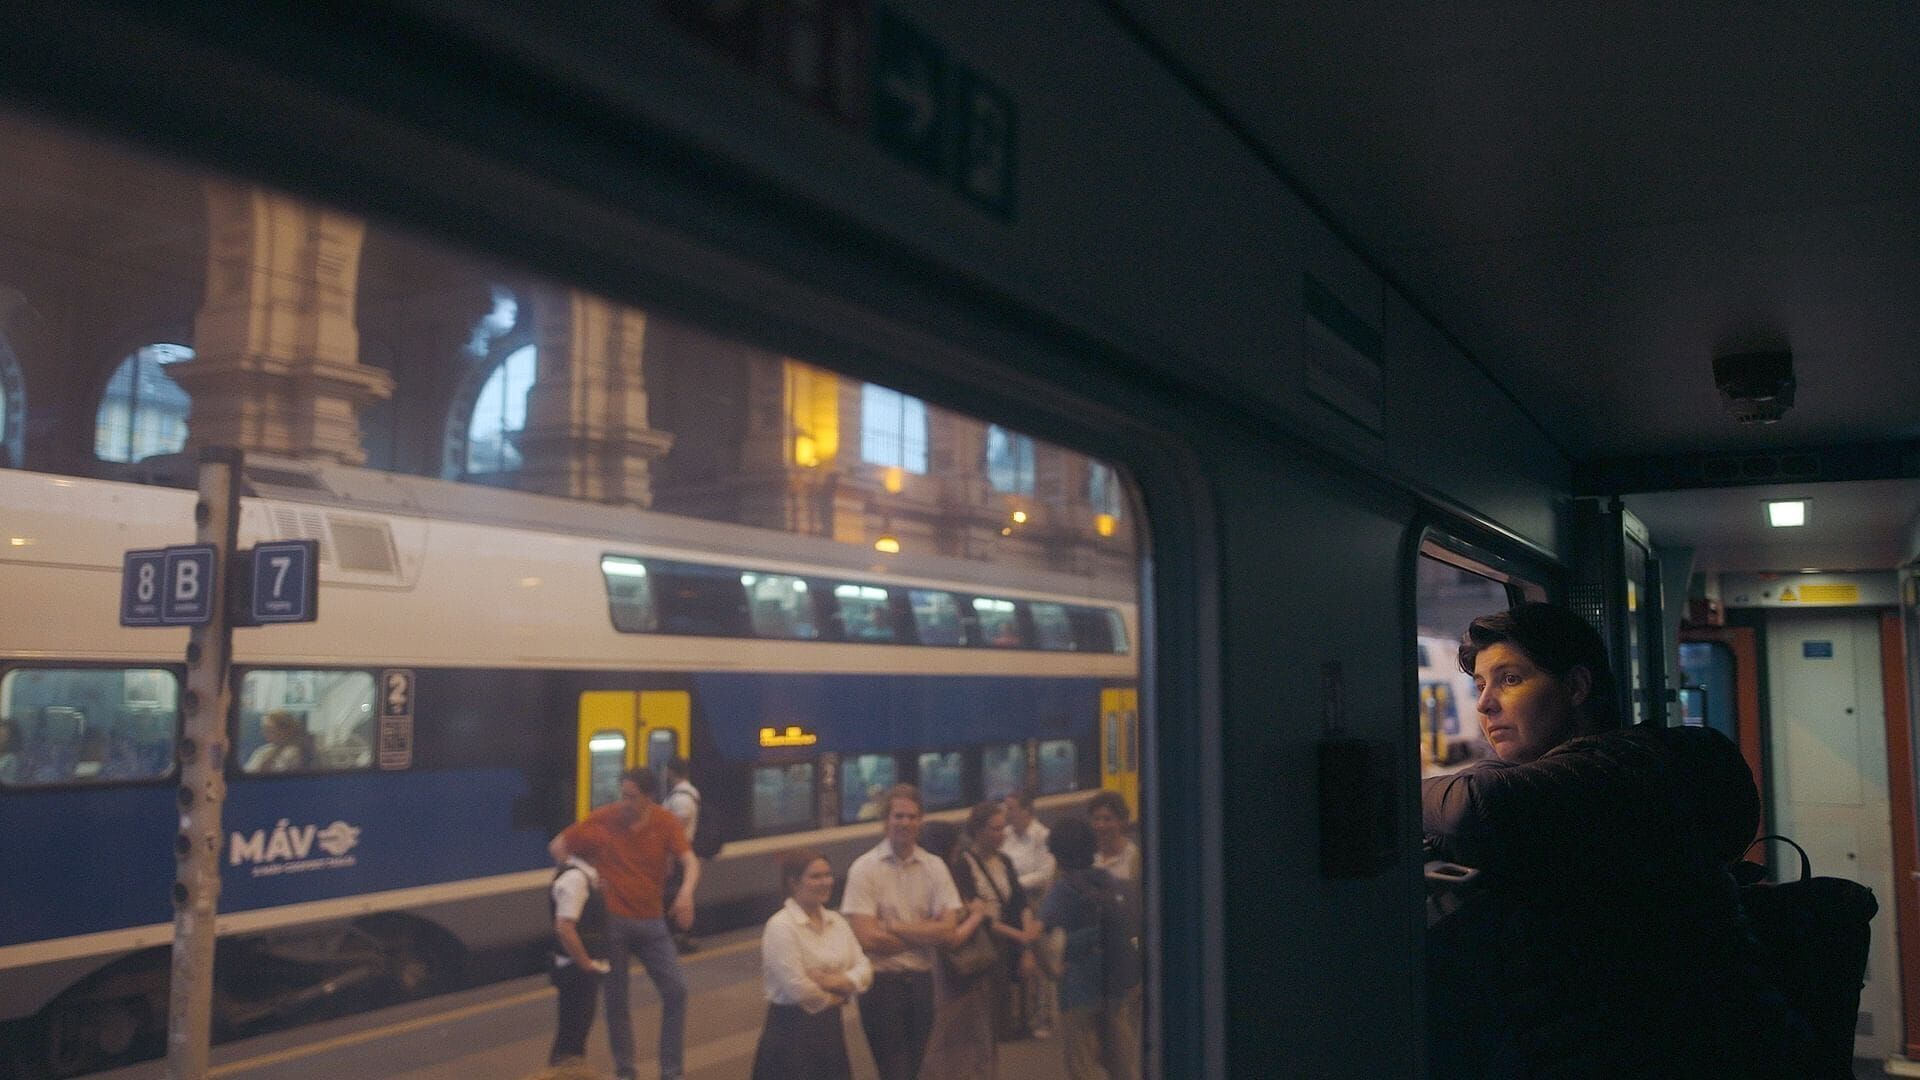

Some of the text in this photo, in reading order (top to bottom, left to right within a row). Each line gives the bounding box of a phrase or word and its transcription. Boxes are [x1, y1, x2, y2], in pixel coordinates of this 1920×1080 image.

[138, 562, 154, 602] 8
[176, 560, 198, 600] B
[271, 556, 290, 599] 7
[388, 673, 408, 704] 2
[229, 818, 317, 867] MÁV
